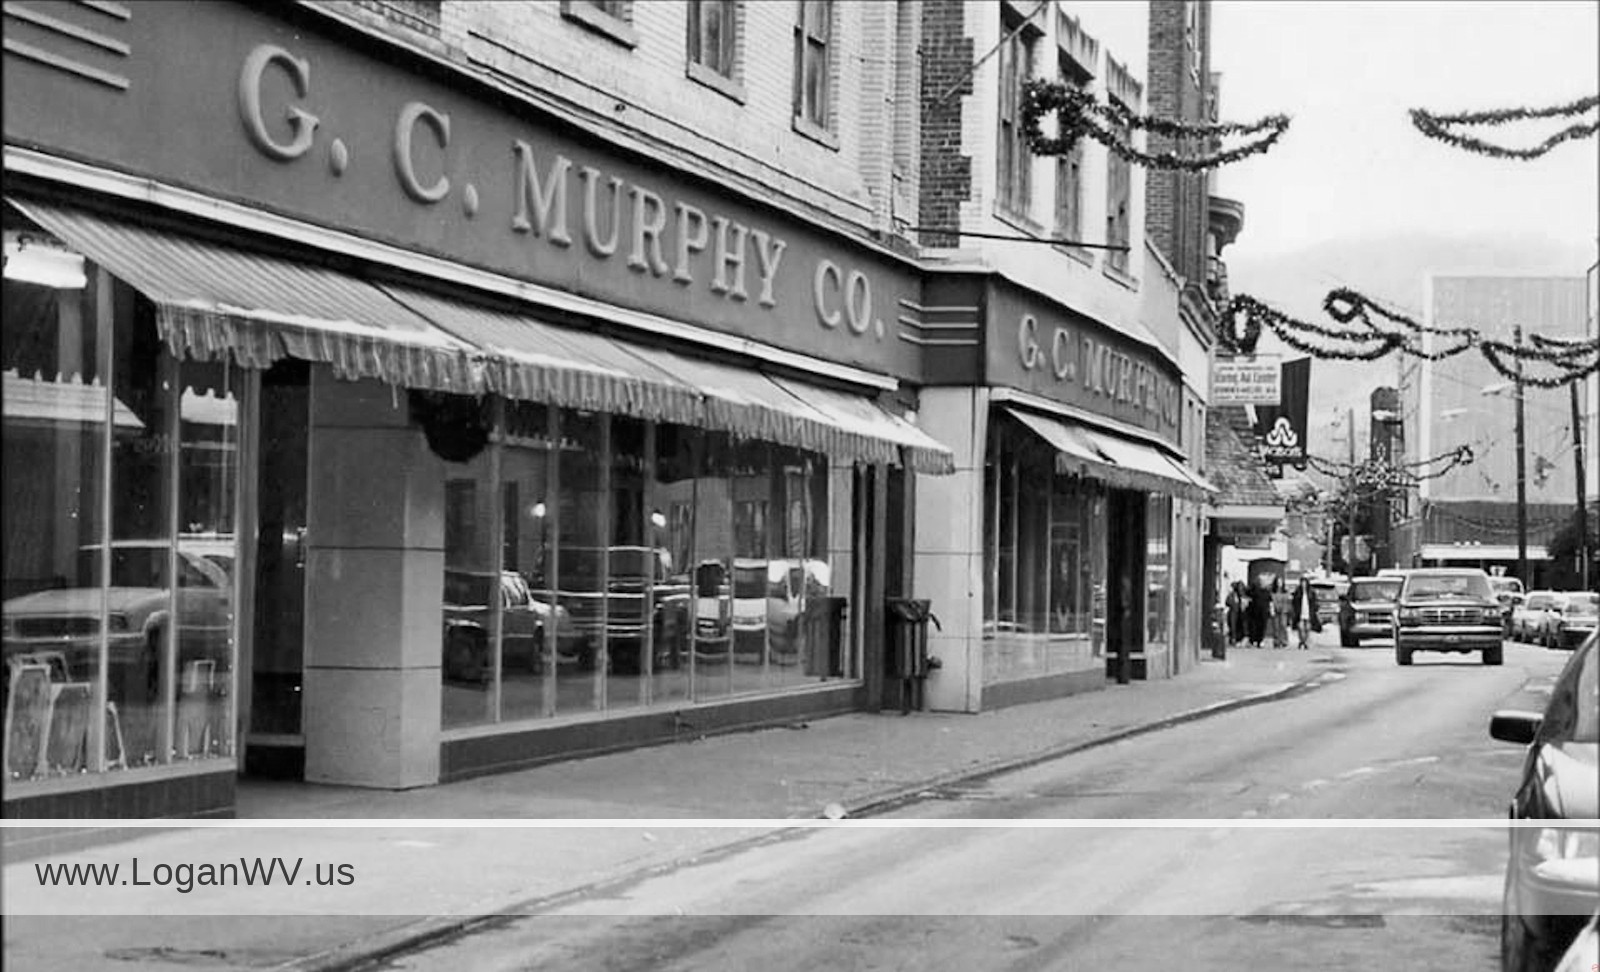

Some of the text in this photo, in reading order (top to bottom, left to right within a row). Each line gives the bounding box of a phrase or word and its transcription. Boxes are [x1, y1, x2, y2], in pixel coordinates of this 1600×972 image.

[238, 43, 885, 340] G. C. MURPHY CO.
[1018, 313, 1046, 370] G.
[1052, 327, 1076, 381] C.
